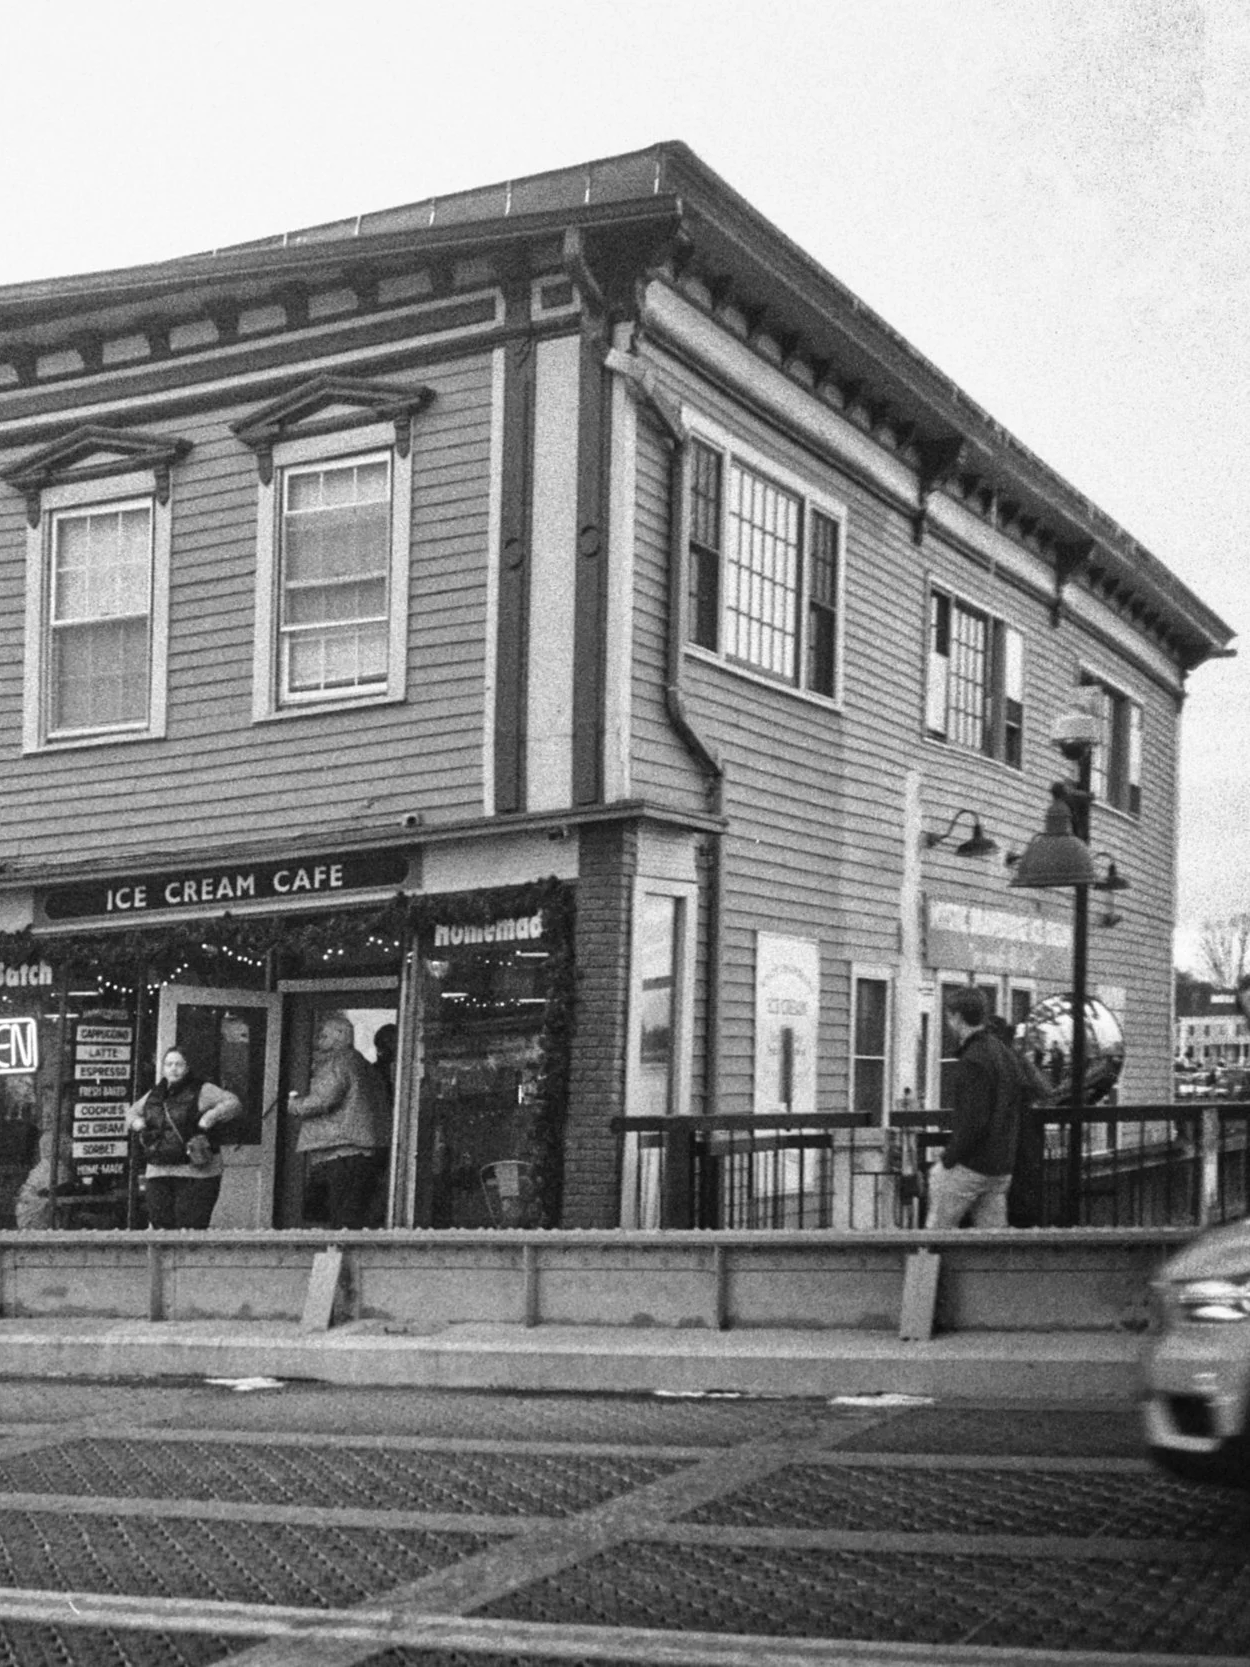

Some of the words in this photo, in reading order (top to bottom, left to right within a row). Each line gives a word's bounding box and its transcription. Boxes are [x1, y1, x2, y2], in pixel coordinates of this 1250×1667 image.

[107, 885, 147, 910] ICE
[164, 874, 256, 904] CREAM
[273, 864, 344, 894] CAFE
[89, 1048, 118, 1059] LATTE
[80, 1066, 127, 1077] ESPRESSO
[81, 1104, 125, 1116] COOKIES
